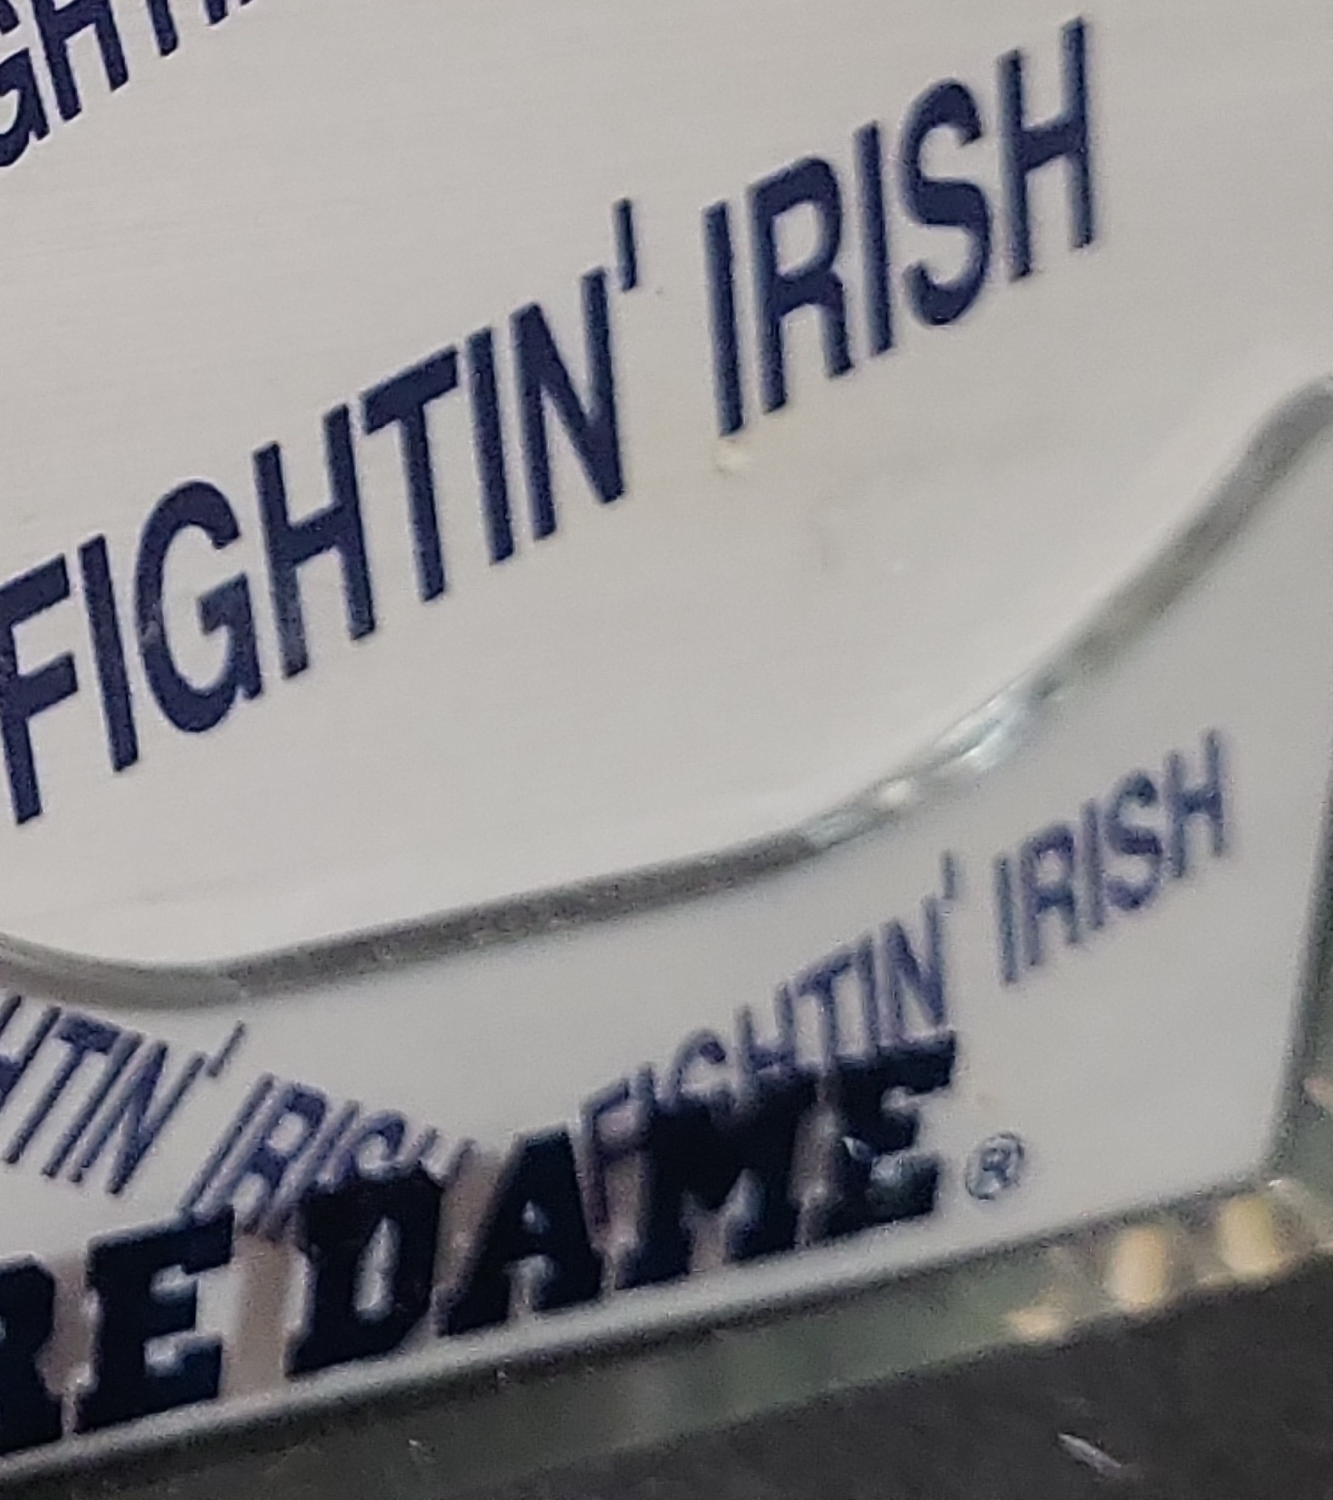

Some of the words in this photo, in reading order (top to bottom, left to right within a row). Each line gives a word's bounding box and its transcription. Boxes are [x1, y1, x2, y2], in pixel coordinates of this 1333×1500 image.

[703, 16, 1098, 438] IRISH
[991, 728, 1230, 986] IRISH
[282, 1030, 959, 1380] DAME
